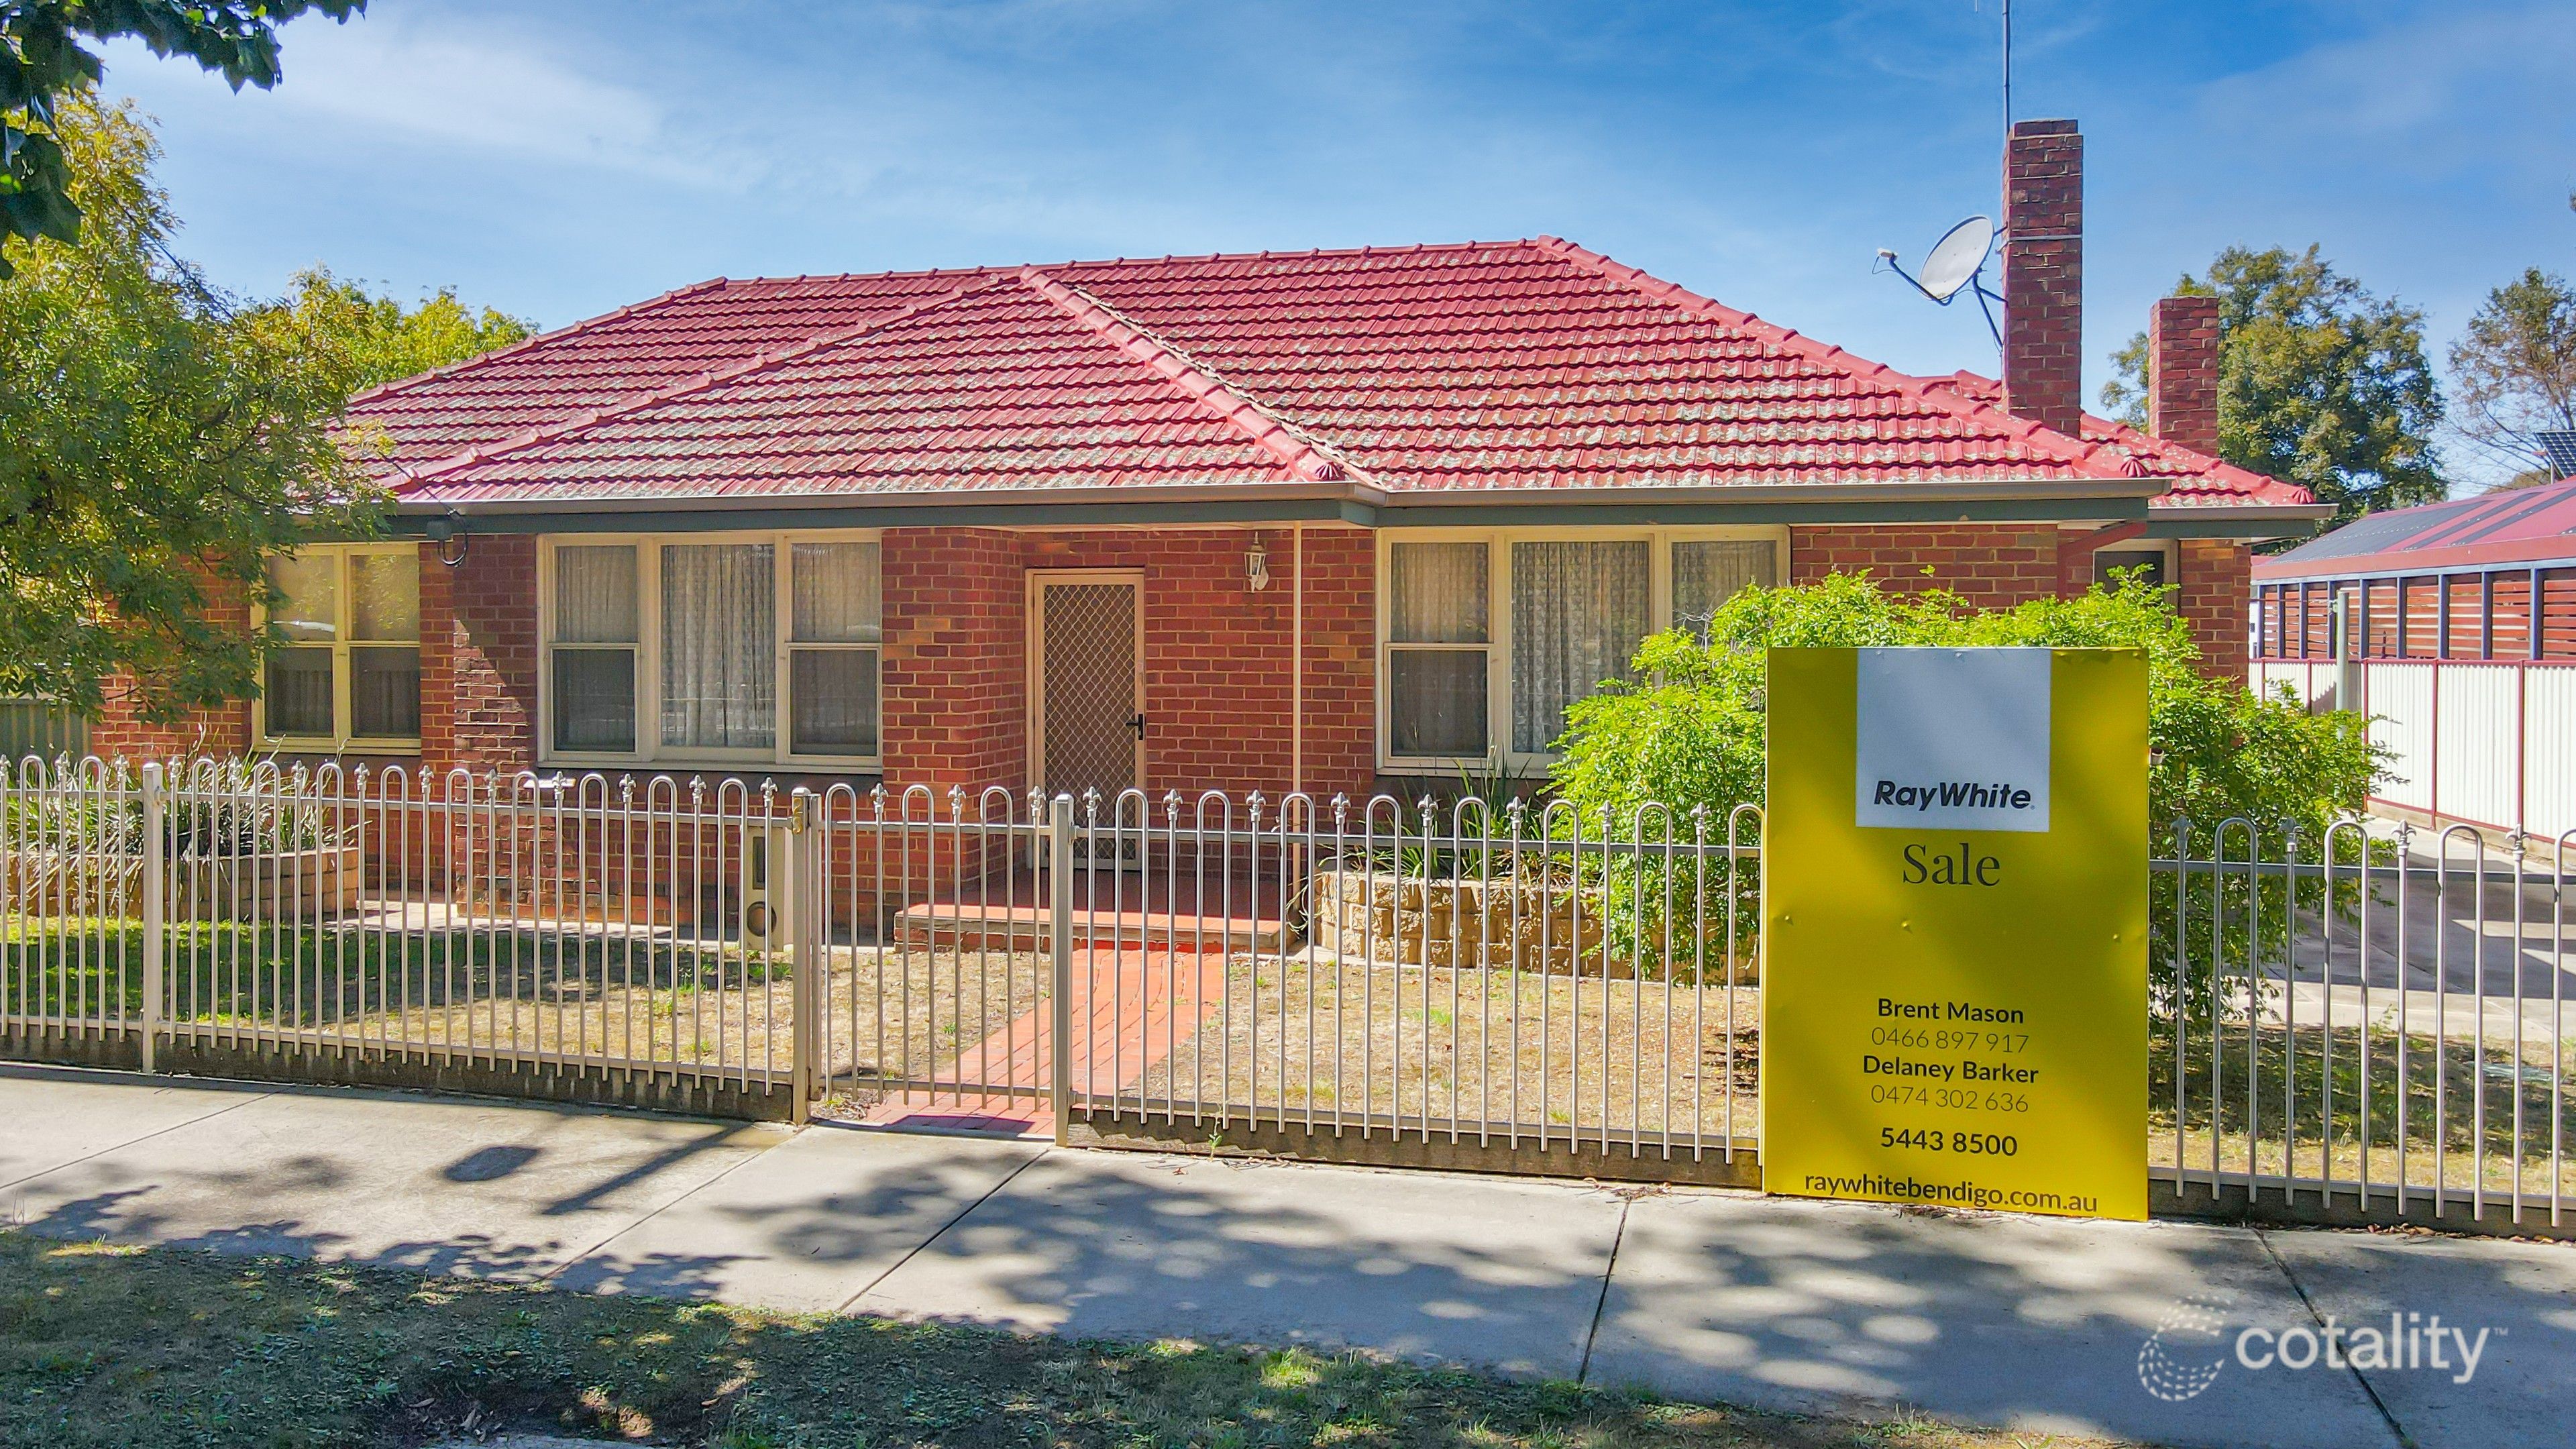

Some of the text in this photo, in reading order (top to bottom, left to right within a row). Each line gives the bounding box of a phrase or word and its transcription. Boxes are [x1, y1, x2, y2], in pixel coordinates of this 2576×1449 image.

[1902, 842, 2001, 885] Sale
[1878, 998, 2025, 1024] Brent Mason
[1871, 1027, 2030, 1054] 0466 897 917
[1863, 1055, 2040, 1084] Delaney Barker
[1870, 1084, 2029, 1113] 0474 302 636
[1880, 1127, 2018, 1157] 5443 8500
[1805, 1173, 2098, 1213] raywhitebendigo.com.au
